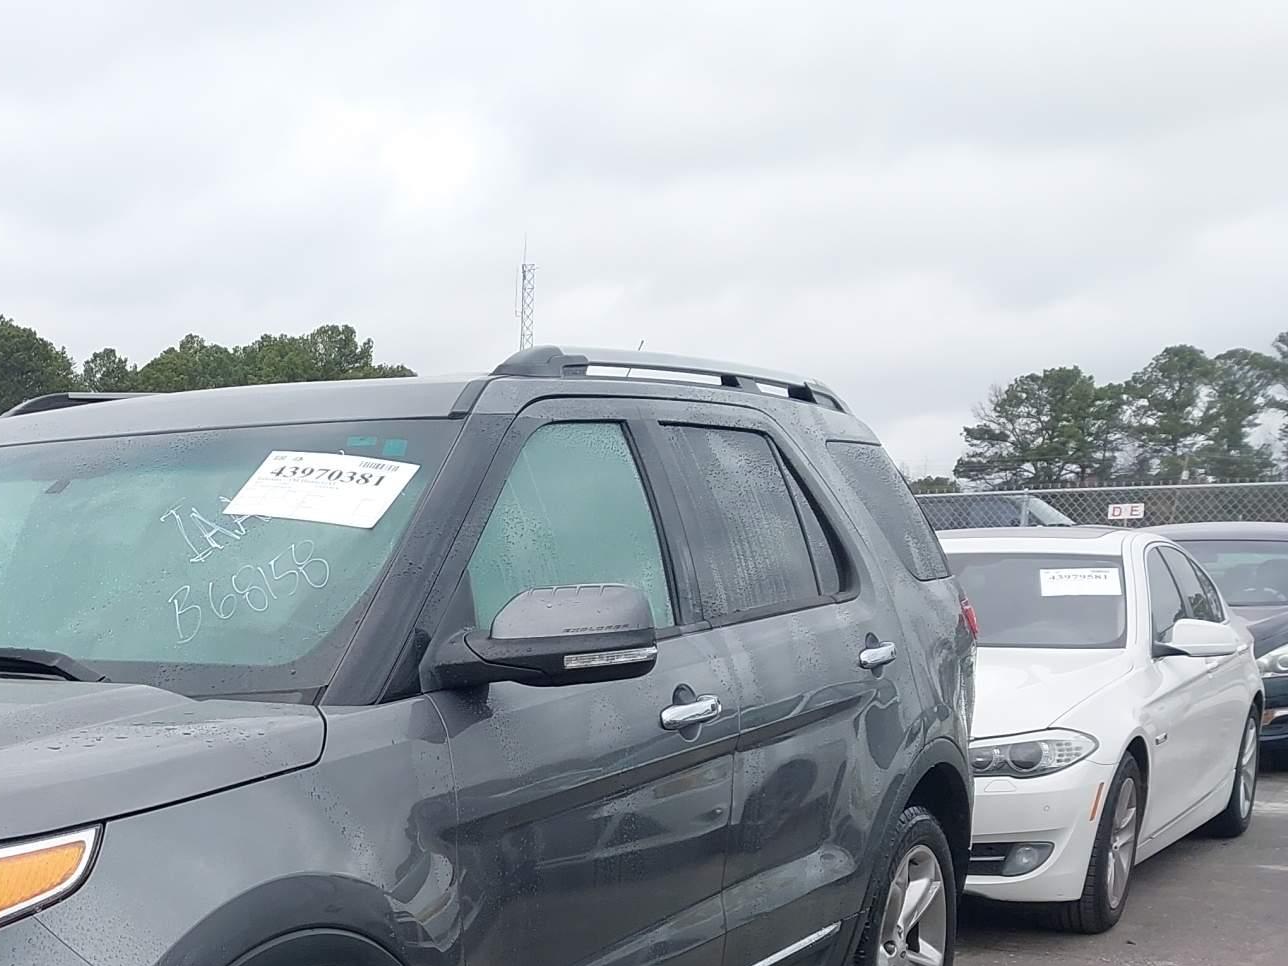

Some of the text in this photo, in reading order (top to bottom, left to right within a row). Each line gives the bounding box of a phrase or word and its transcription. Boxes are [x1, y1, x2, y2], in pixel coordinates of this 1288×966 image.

[270, 465, 387, 487] 43970381
[1112, 505, 1141, 517] D E
